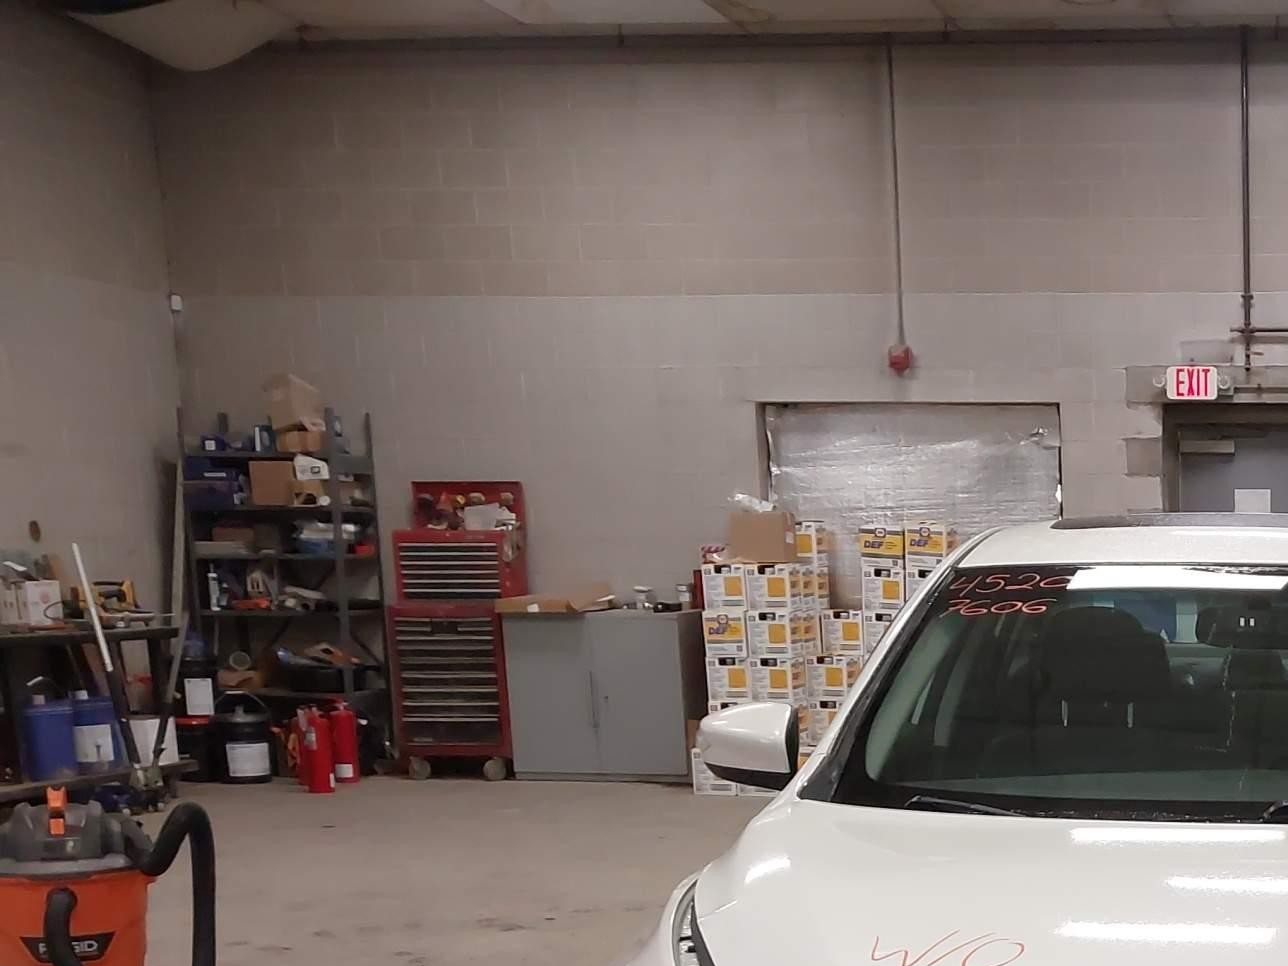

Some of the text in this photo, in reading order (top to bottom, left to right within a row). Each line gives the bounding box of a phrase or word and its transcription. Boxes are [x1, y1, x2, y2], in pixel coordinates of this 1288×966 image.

[1176, 368, 1211, 397] EXIT
[863, 540, 885, 549] DEF
[909, 538, 929, 547] DEF
[949, 573, 1074, 598] 4520
[940, 598, 1058, 618] 7606
[38, 940, 98, 954] RGID
